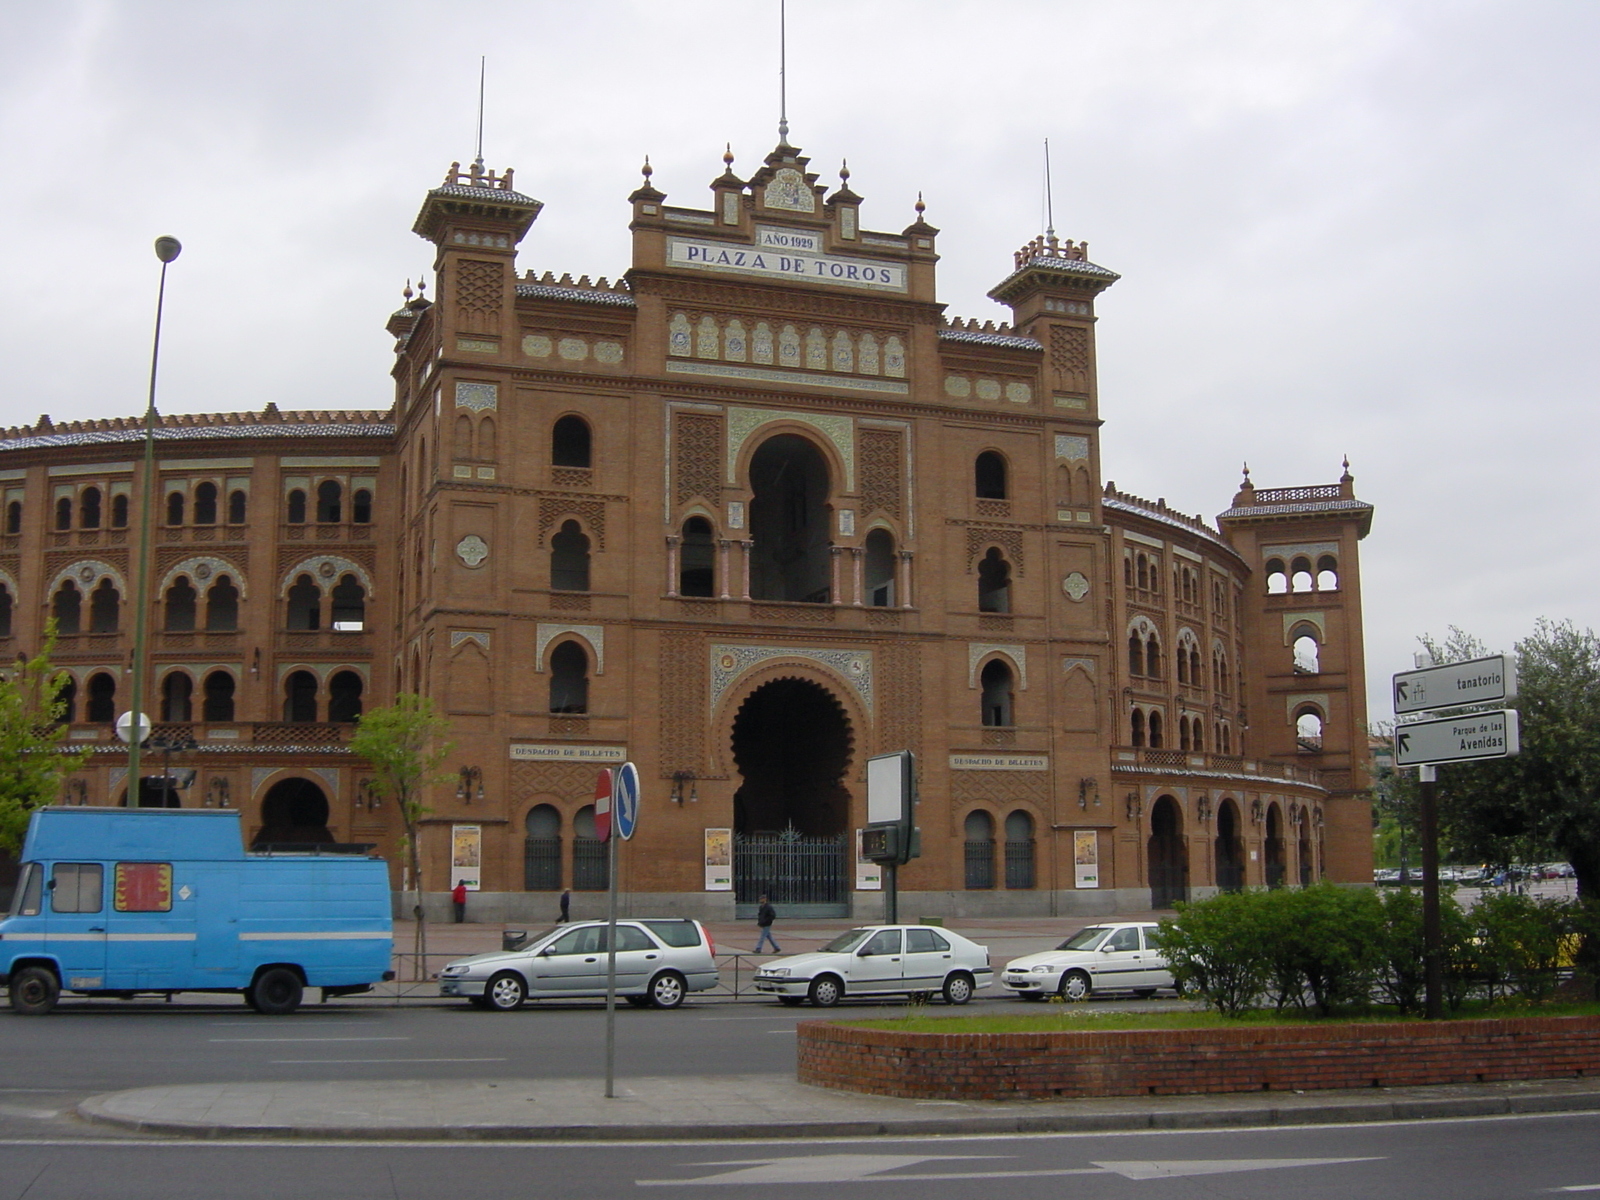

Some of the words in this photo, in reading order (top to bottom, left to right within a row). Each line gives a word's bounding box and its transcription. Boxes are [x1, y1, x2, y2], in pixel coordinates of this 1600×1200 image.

[764, 232, 788, 246] AÑO
[791, 236, 813, 249] 1929
[687, 246, 767, 269] PLAZA
[780, 257, 805, 273] DE
[814, 261, 891, 283] TOROS
[1457, 672, 1501, 690] tanatorio
[1453, 726, 1476, 736] Parque
[1480, 723, 1488, 733] de
[1491, 722, 1502, 731] las
[1460, 736, 1503, 751] Avenidas
[515, 748, 560, 756] DESPACHO
